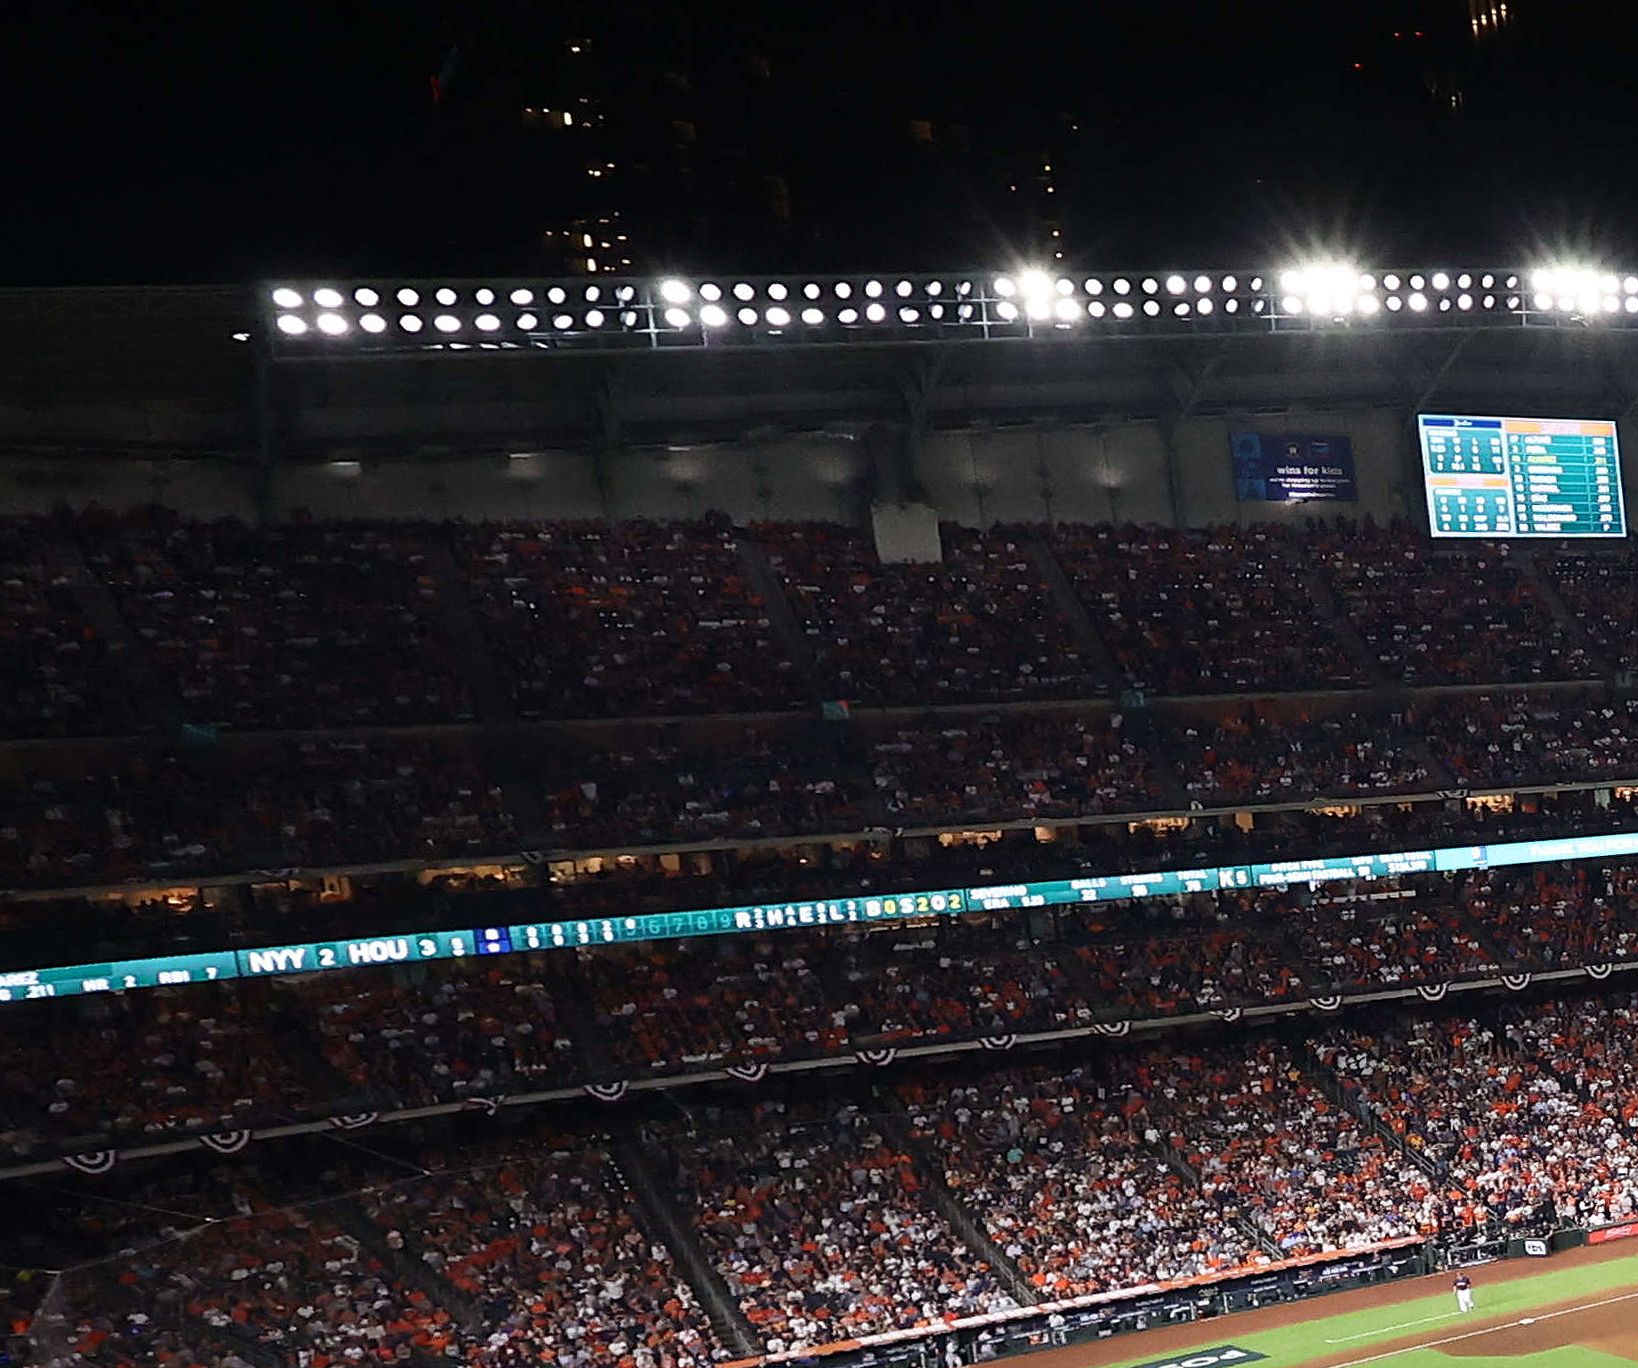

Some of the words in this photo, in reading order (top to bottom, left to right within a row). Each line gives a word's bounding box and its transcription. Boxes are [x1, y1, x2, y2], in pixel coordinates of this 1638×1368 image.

[830, 905, 844, 920] L
[866, 901, 881, 916] B
[899, 899, 913, 913] S
[918, 898, 928, 911] 2
[949, 895, 960, 908] 2
[736, 912, 751, 928] R
[800, 907, 813, 921] E
[250, 948, 305, 973] NYY
[319, 948, 336, 966] 2
[349, 938, 408, 964] HOU
[419, 939, 436, 956] 3
